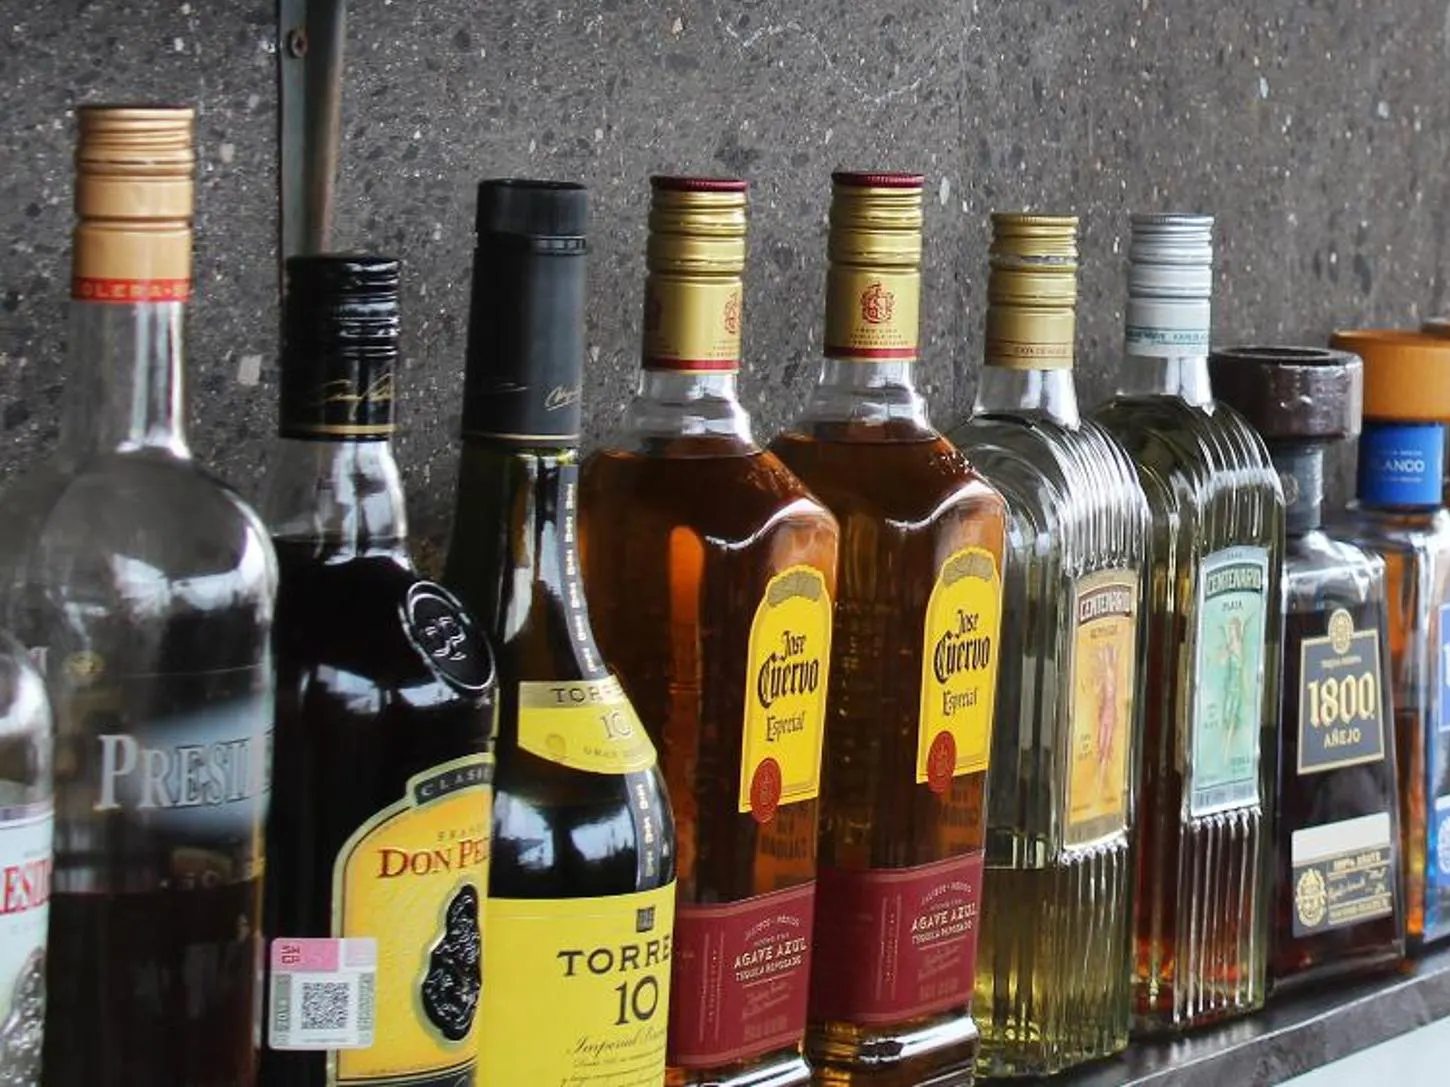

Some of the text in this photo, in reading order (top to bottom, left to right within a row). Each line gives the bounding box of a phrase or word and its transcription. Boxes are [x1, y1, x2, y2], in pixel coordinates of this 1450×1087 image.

[934, 630, 991, 684] Cuervo
[758, 652, 820, 709] Cuervo
[1307, 672, 1376, 729] 1800
[767, 711, 806, 742] Especial
[1324, 728, 1362, 750] AÑEJO
[374, 848, 452, 879] DON
[911, 910, 949, 933] AGAVE
[951, 902, 978, 924] AZUL
[556, 934, 672, 977] TORRE
[734, 945, 774, 970] AGAVE
[776, 937, 807, 959] AZUL
[614, 975, 659, 1026] 10
